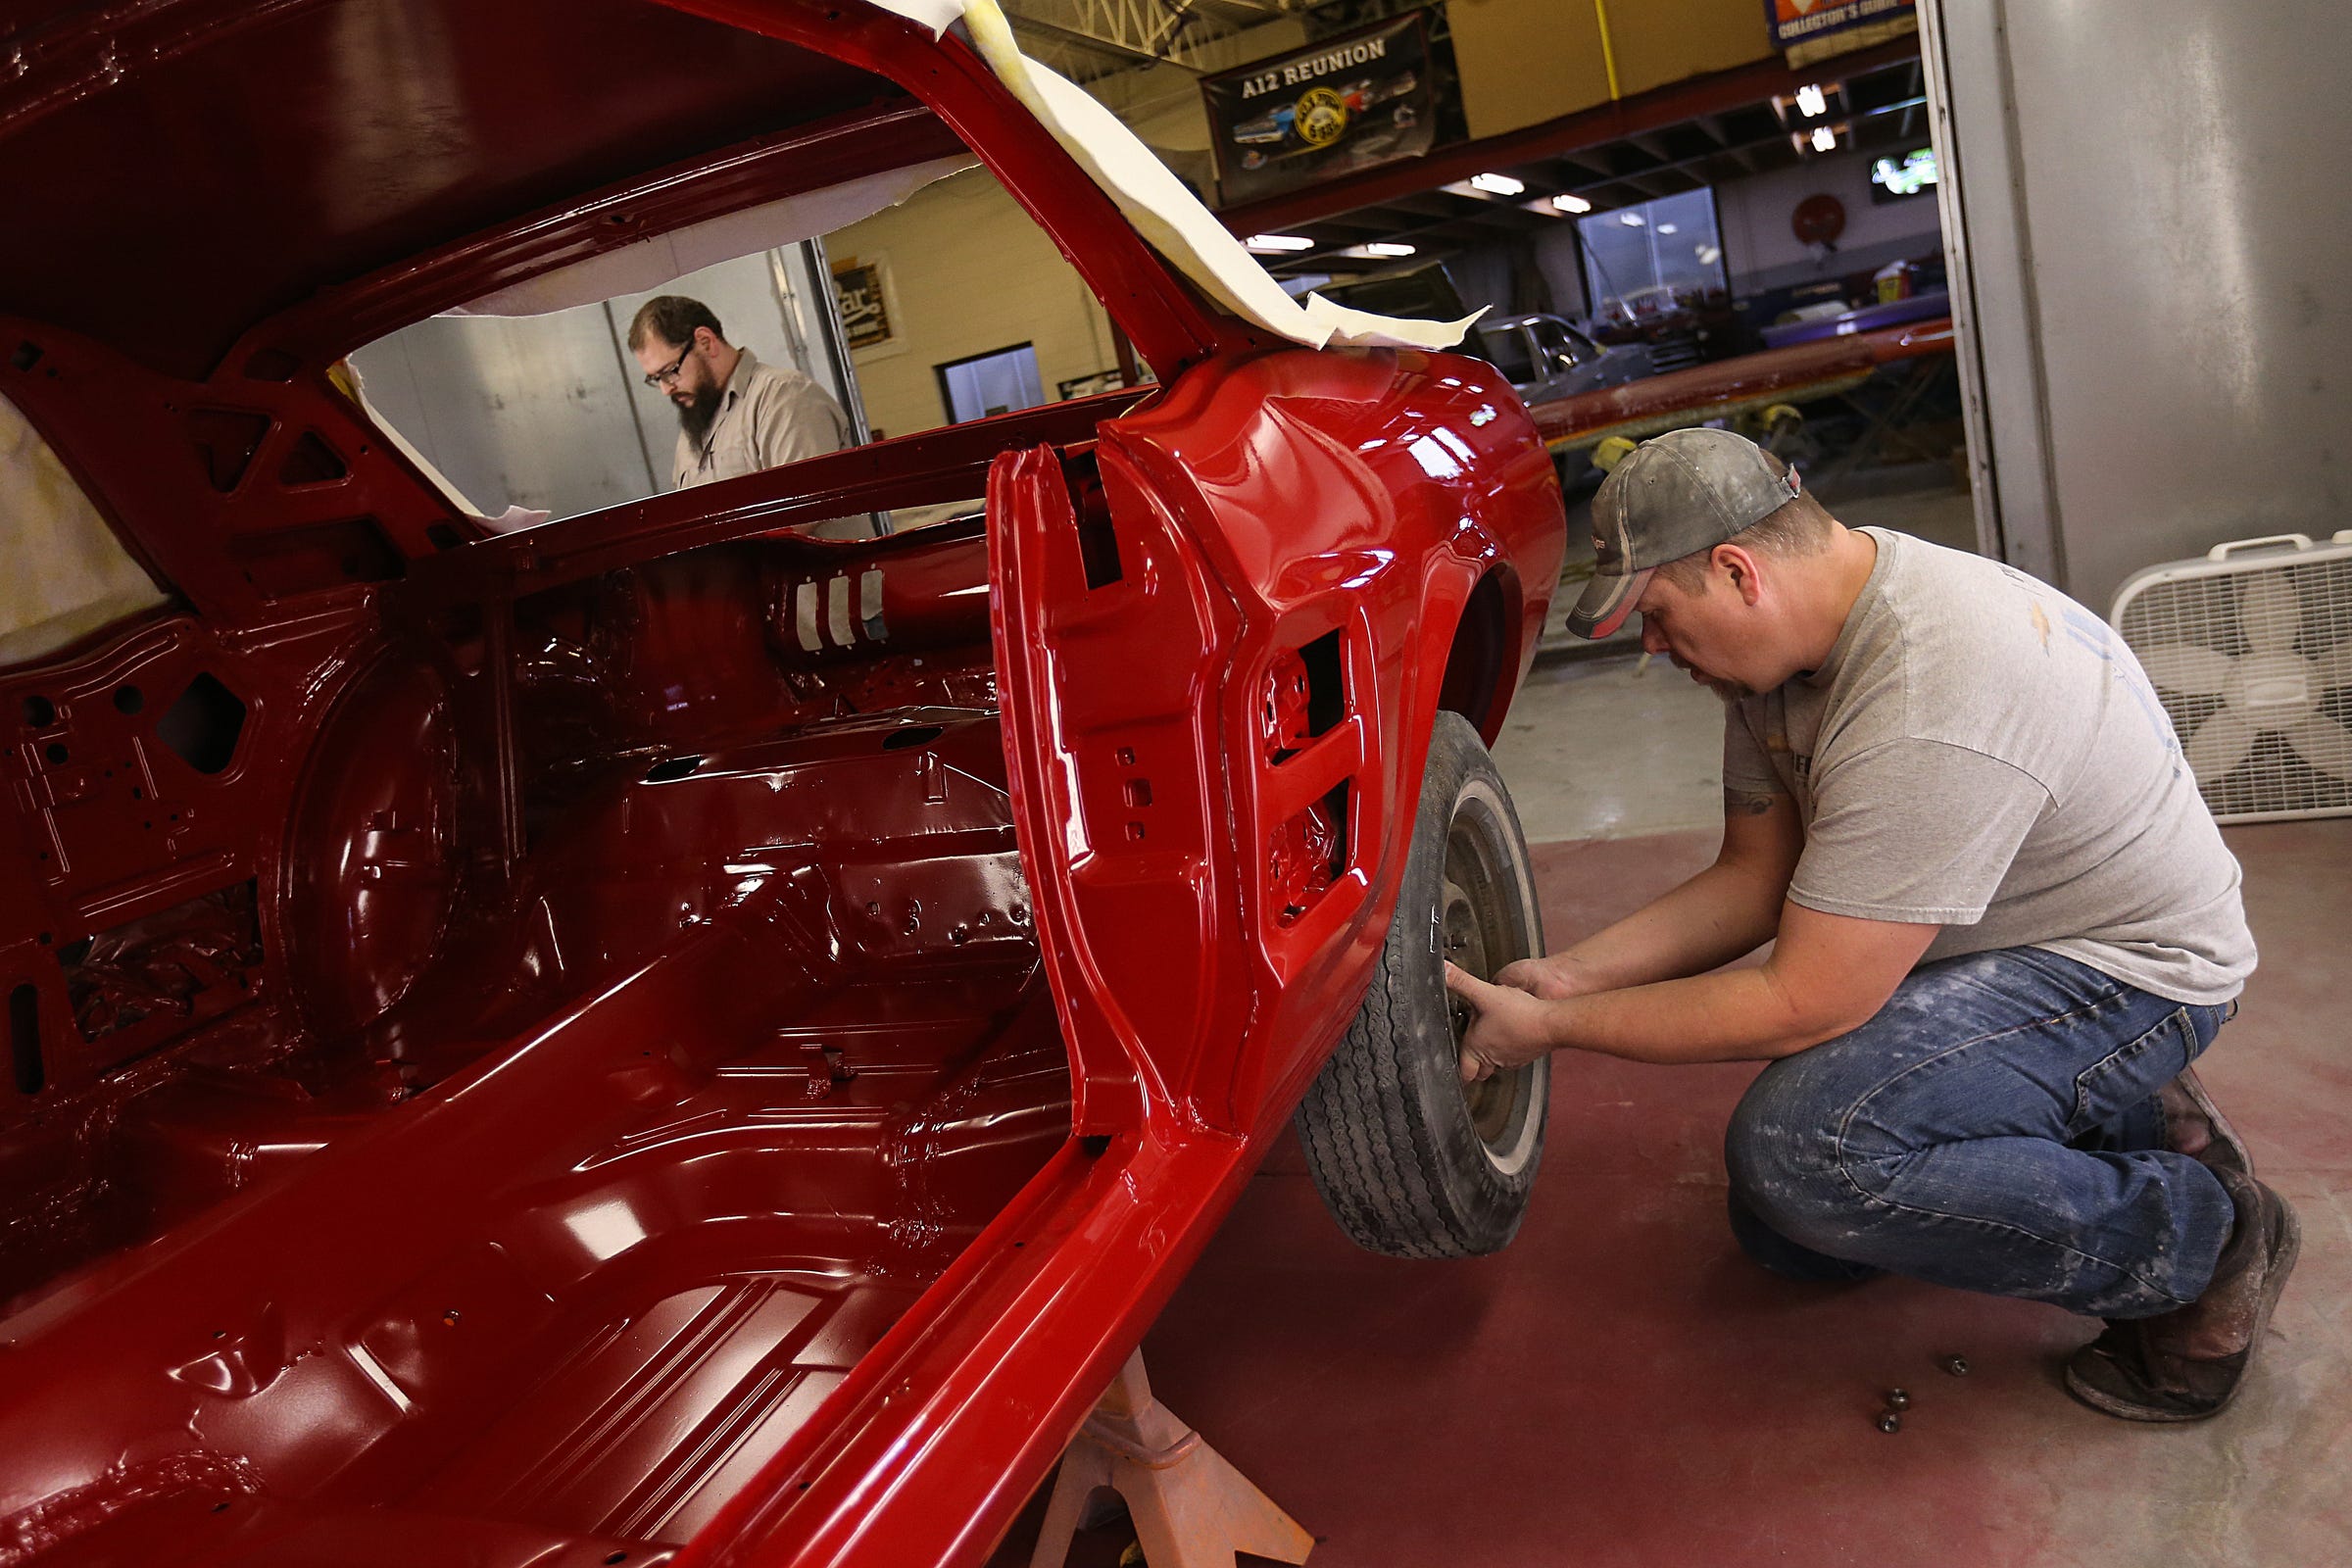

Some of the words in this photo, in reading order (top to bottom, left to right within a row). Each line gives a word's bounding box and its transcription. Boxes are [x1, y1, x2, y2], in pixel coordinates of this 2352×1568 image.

[1779, 3, 1858, 39] COLLECTOR'S
[1242, 73, 1280, 99] A12
[1283, 37, 1386, 86] REUNION
